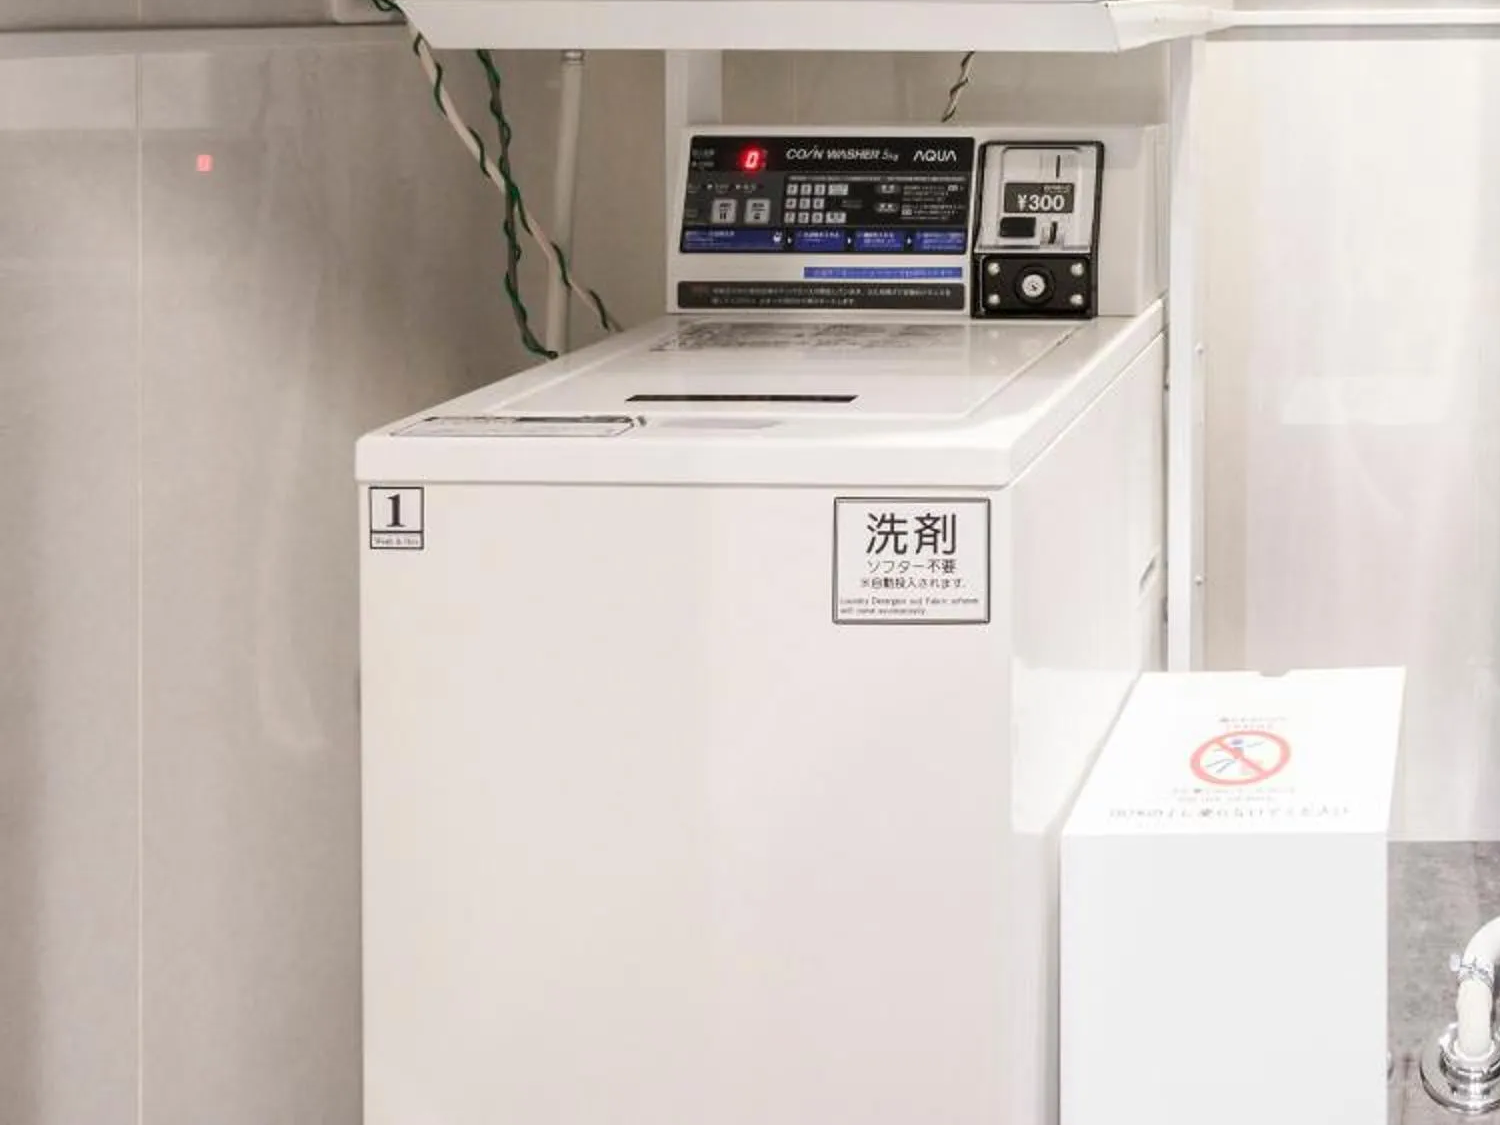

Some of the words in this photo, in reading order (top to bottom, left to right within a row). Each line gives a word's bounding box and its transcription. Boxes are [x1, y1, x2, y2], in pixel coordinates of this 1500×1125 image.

[827, 148, 880, 161] WASHER
[912, 148, 958, 162] AQUA
[1017, 193, 1065, 211] ¥300
[384, 492, 408, 528] 1
[865, 512, 957, 556] 洗剤
[866, 558, 957, 574] ソフター不要
